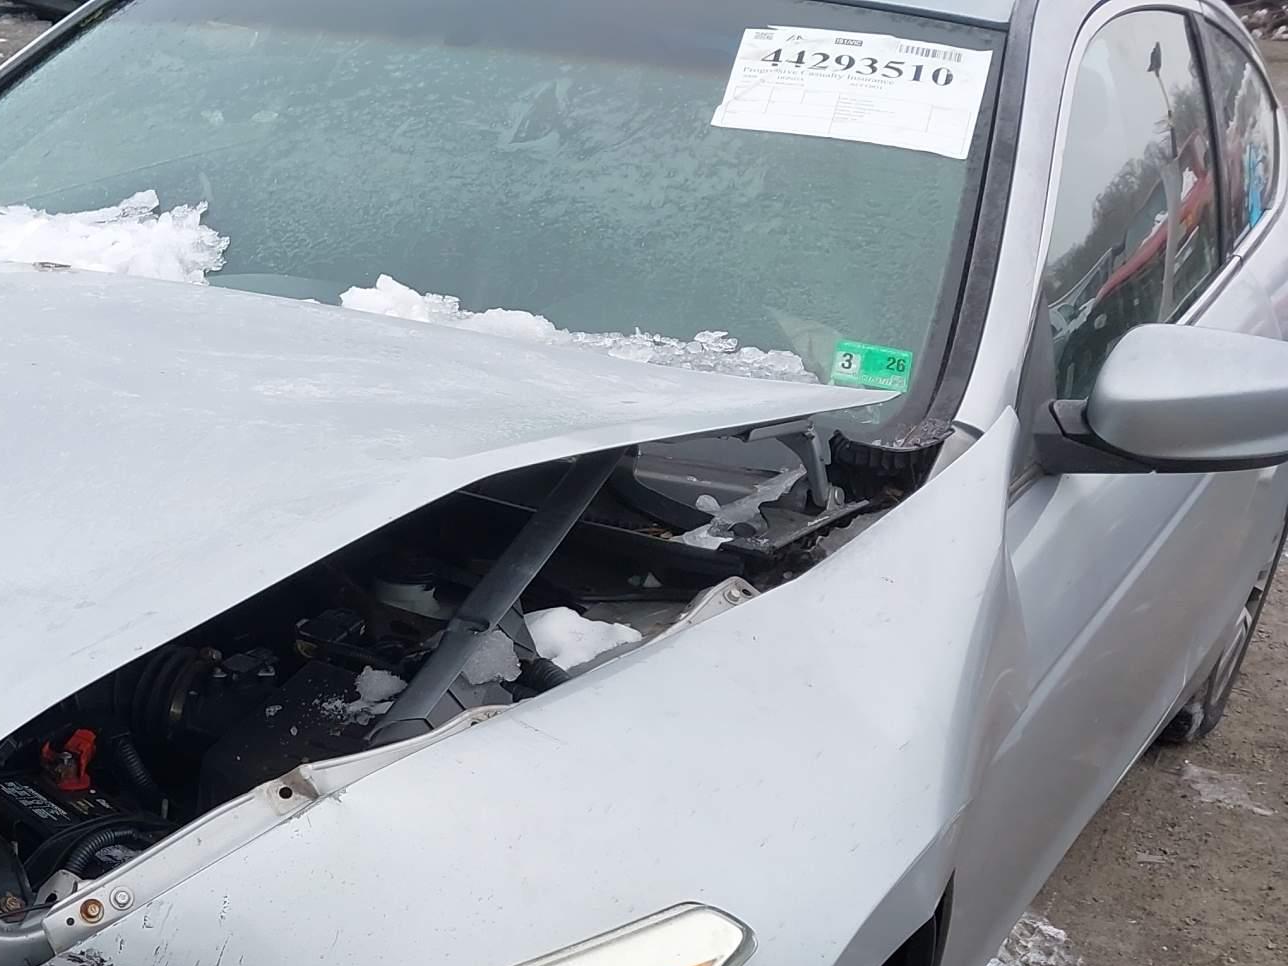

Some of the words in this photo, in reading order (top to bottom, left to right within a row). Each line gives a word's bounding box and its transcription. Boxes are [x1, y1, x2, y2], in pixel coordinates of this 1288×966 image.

[760, 47, 954, 87] 44293510
[841, 352, 854, 370] 3
[886, 356, 907, 373] 26
